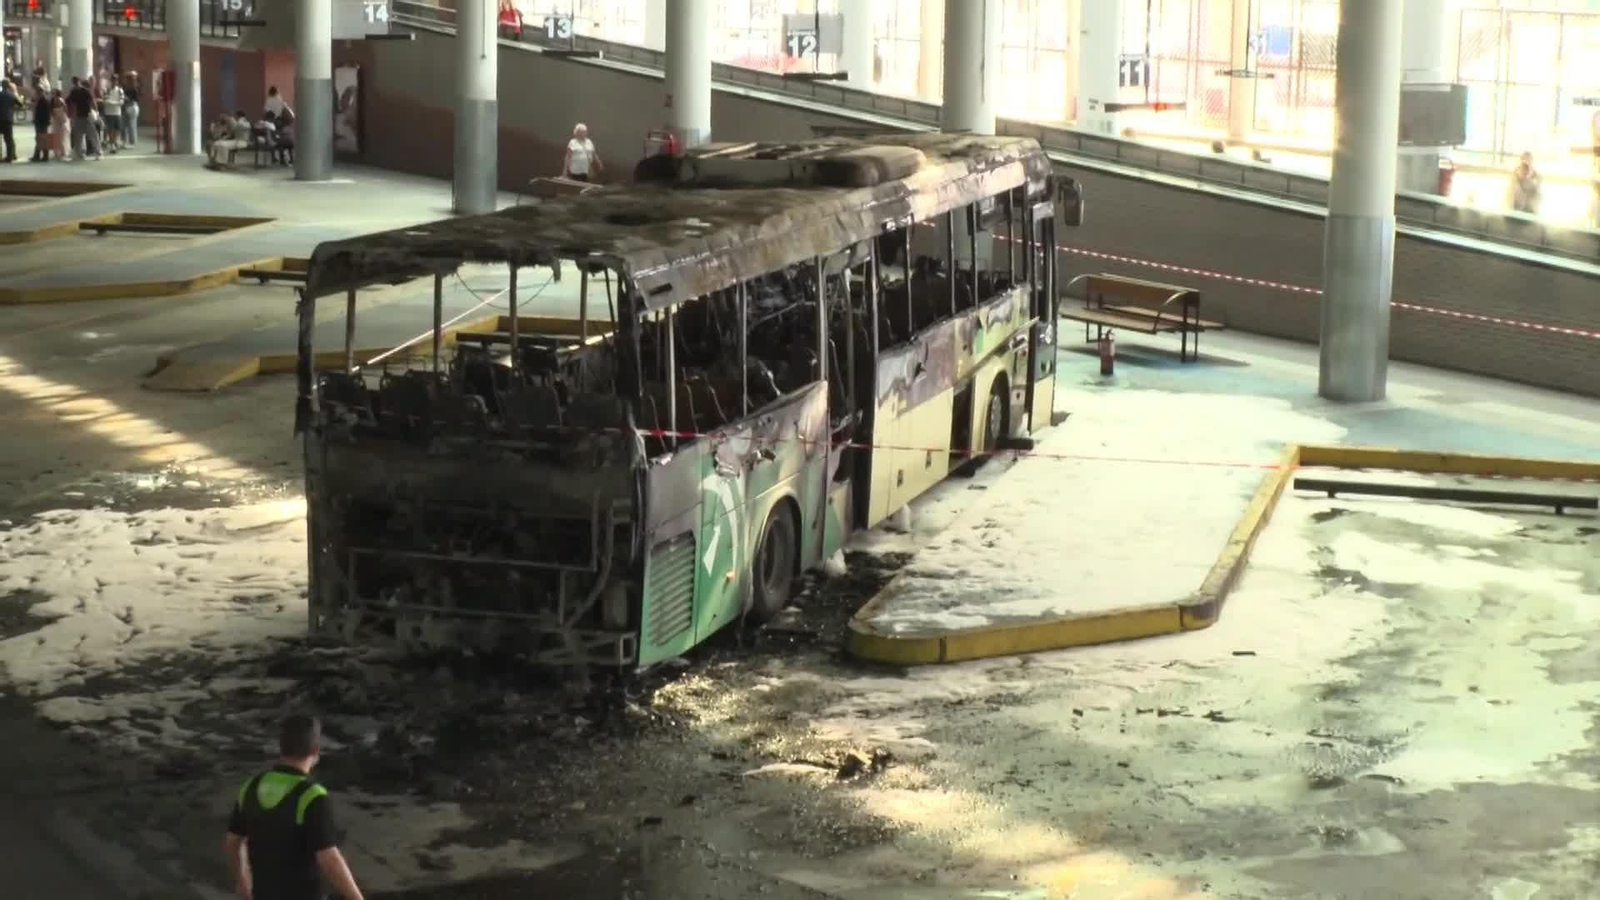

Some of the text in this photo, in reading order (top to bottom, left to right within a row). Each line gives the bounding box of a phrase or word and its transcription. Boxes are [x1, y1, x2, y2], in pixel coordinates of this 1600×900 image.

[365, 4, 388, 23] 14
[545, 18, 571, 38] 13
[788, 35, 817, 58] 12
[1120, 60, 1144, 87] 11
